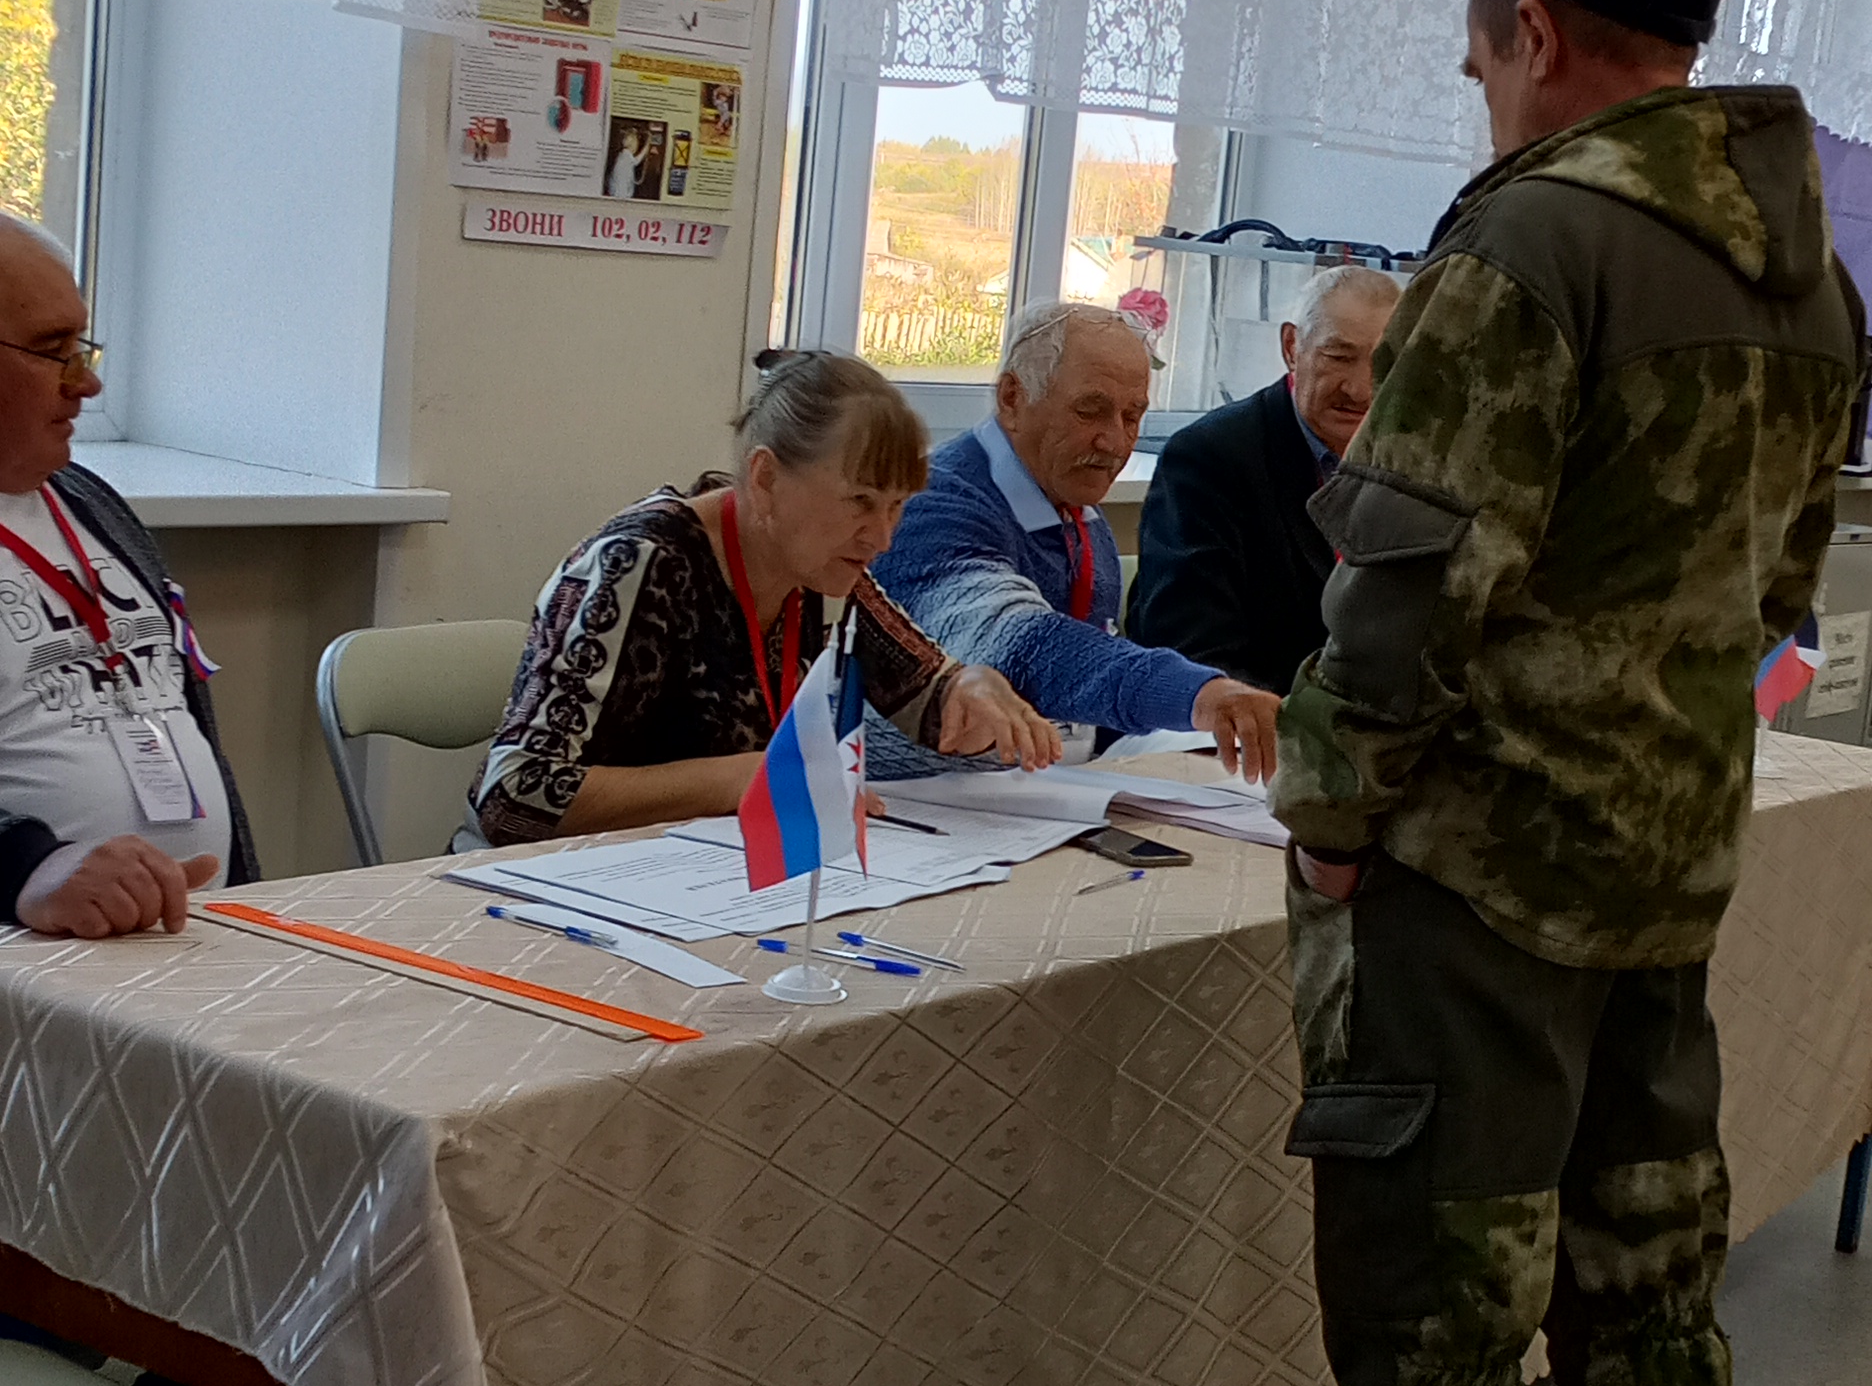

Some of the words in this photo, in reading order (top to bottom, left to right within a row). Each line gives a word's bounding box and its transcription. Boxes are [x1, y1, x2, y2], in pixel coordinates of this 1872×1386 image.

[484, 208, 565, 238] ЗВОНИ
[591, 215, 631, 243] 102,
[638, 220, 667, 246] 02,
[675, 222, 712, 246] 112
